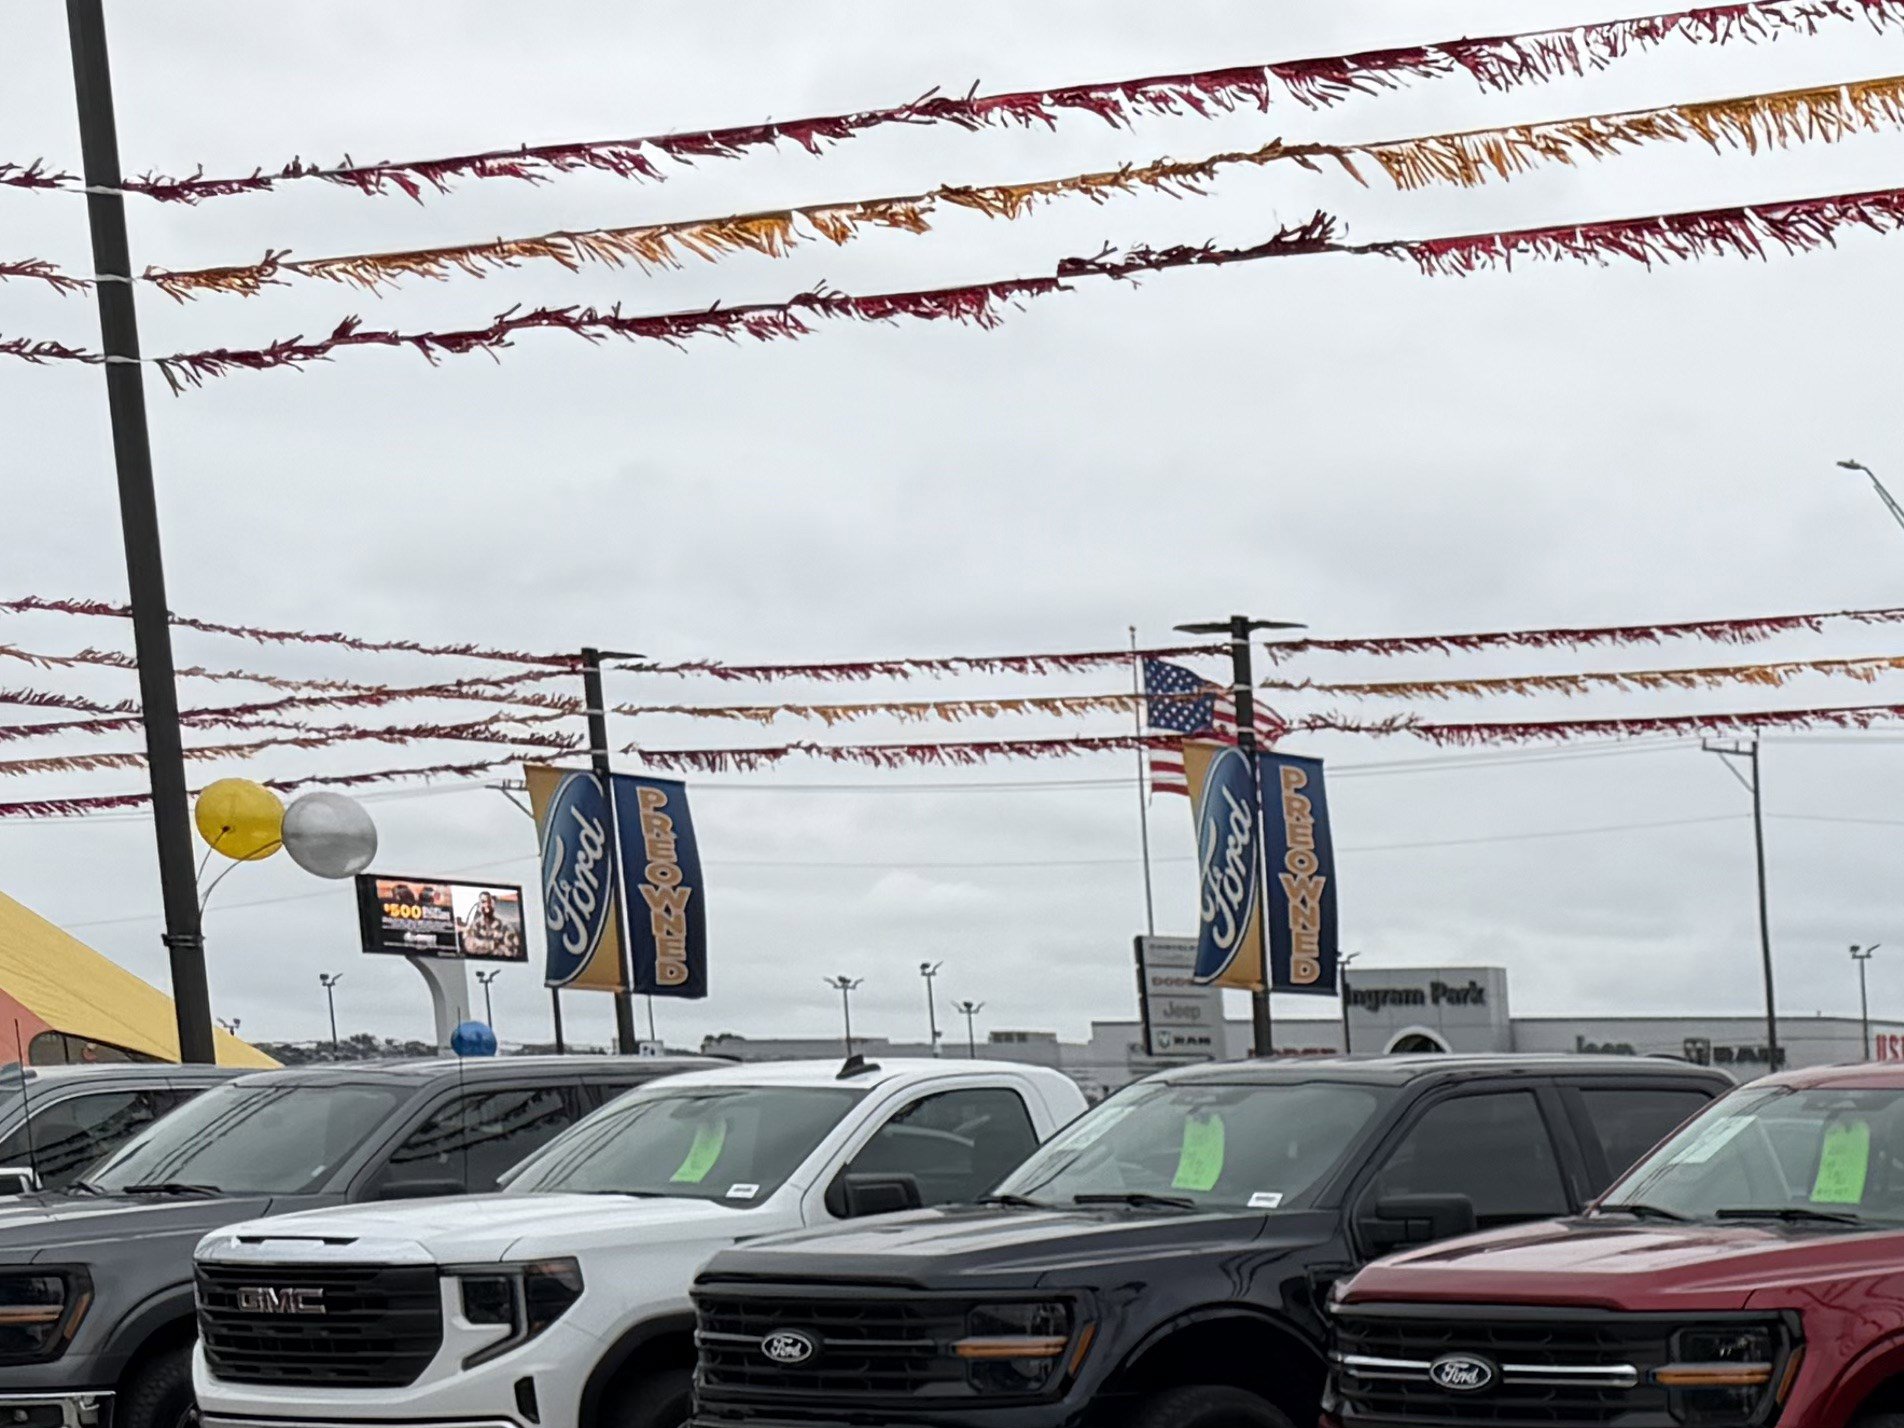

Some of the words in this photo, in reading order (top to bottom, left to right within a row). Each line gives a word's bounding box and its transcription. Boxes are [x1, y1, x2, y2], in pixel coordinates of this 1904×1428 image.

[546, 804, 606, 956] Ford
[635, 785, 693, 986] PREOWNED
[1200, 784, 1253, 949] Ford
[1278, 764, 1327, 984] PREOWNED
[1430, 980, 1486, 1006] Park
[236, 1286, 327, 1314] GMC
